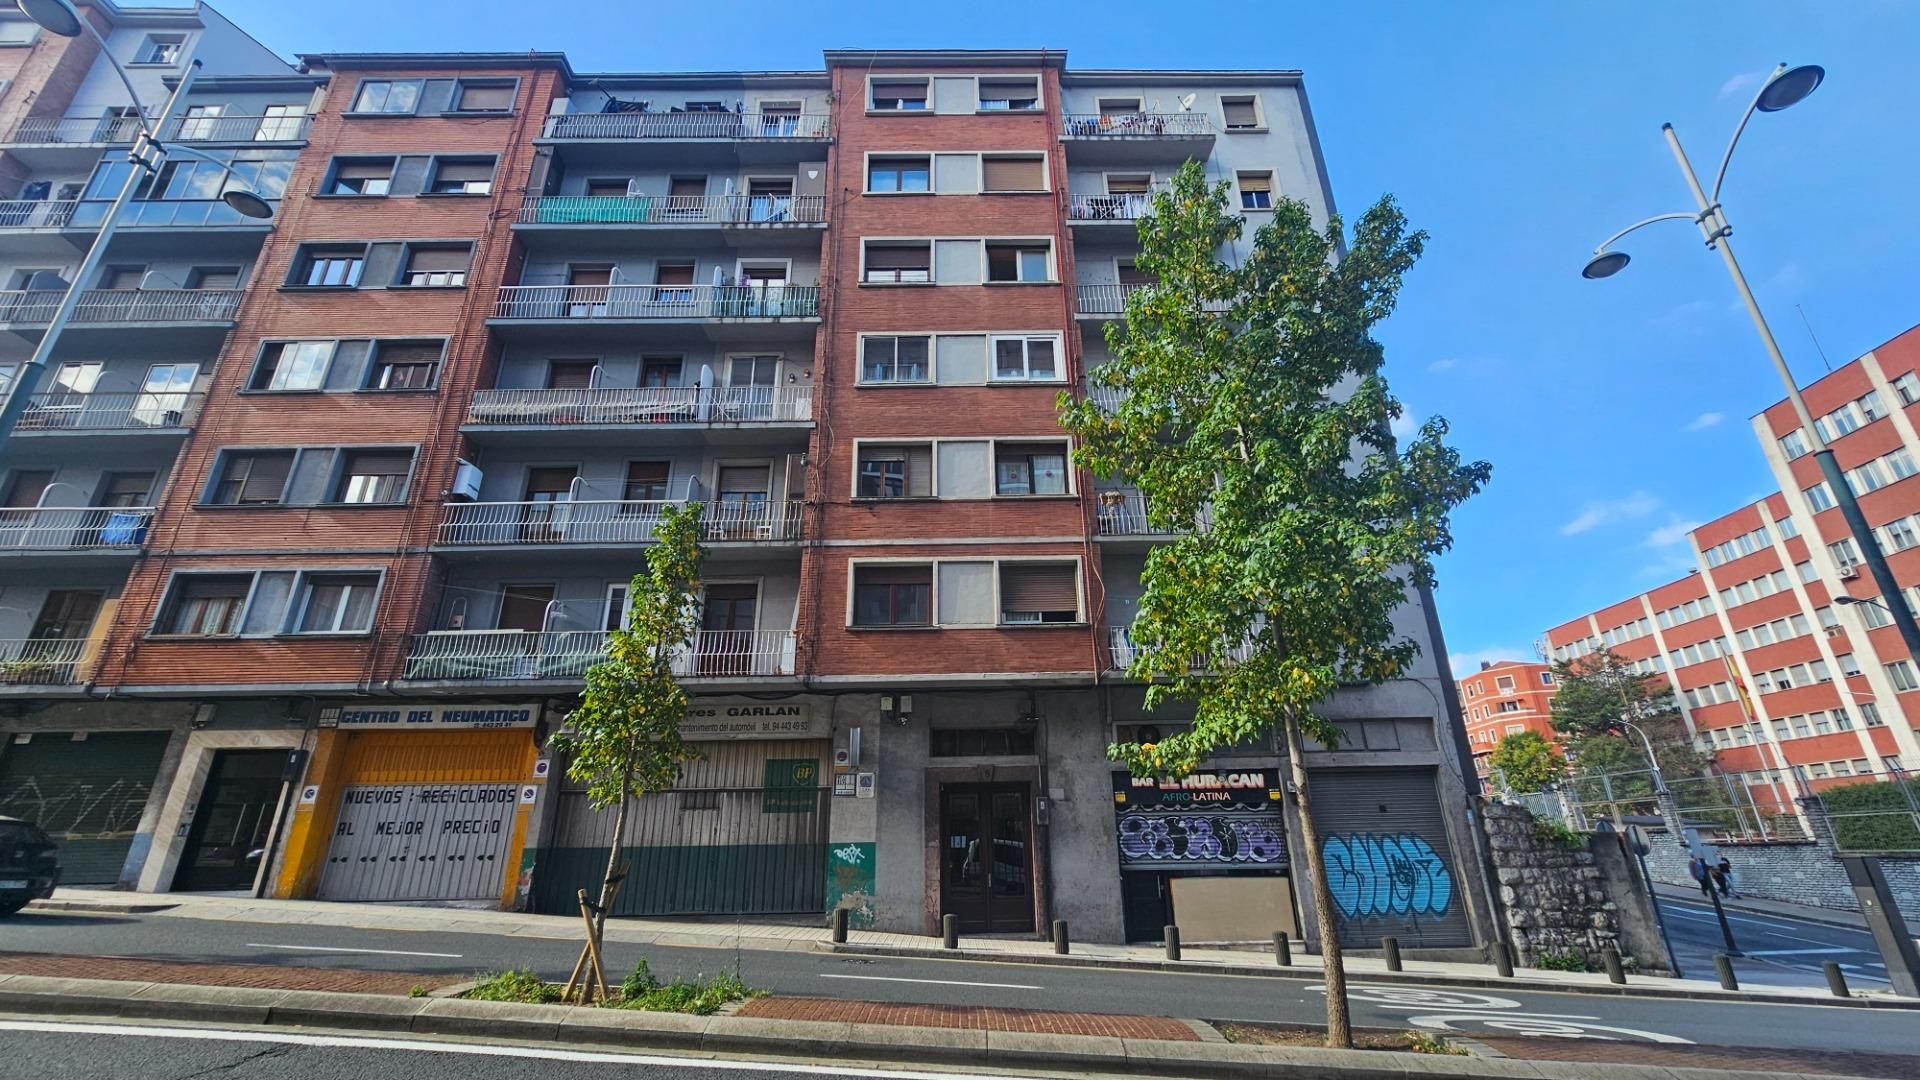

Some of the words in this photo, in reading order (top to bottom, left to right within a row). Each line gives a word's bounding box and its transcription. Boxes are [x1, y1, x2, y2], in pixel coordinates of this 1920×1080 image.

[341, 711, 400, 723] CENTRO
[406, 711, 434, 723] DEL
[441, 710, 530, 723] NEUMATICO
[727, 707, 800, 717] GARLAN
[796, 767, 813, 779] BP
[1132, 777, 1154, 787] BAR
[344, 790, 403, 804] NUEVOS
[337, 824, 355, 836] AL
